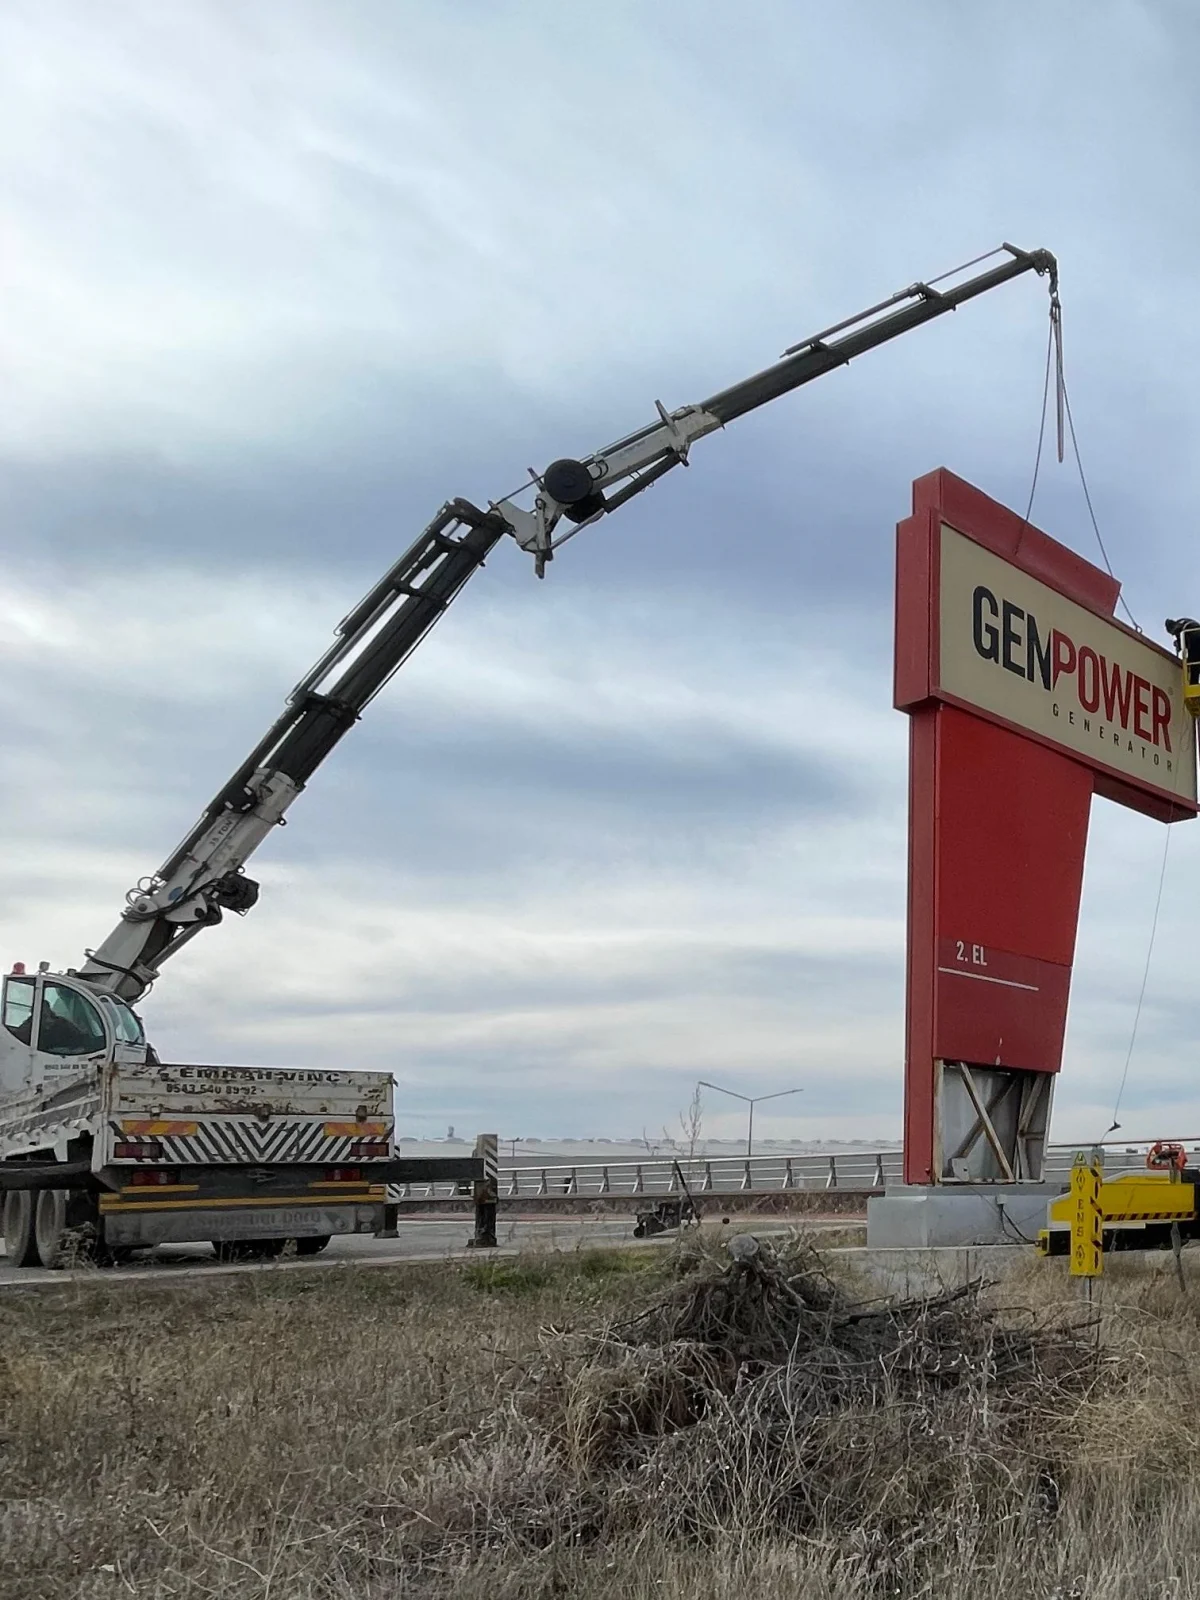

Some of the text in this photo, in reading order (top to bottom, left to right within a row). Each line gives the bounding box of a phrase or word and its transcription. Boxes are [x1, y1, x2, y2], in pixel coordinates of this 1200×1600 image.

[973, 585, 1173, 754] GENPOWER
[1052, 703, 1173, 773] GENERATOR
[218, 819, 233, 836] TON
[956, 940, 988, 966] 2. EL
[1076, 1198, 1085, 1237] ENS
